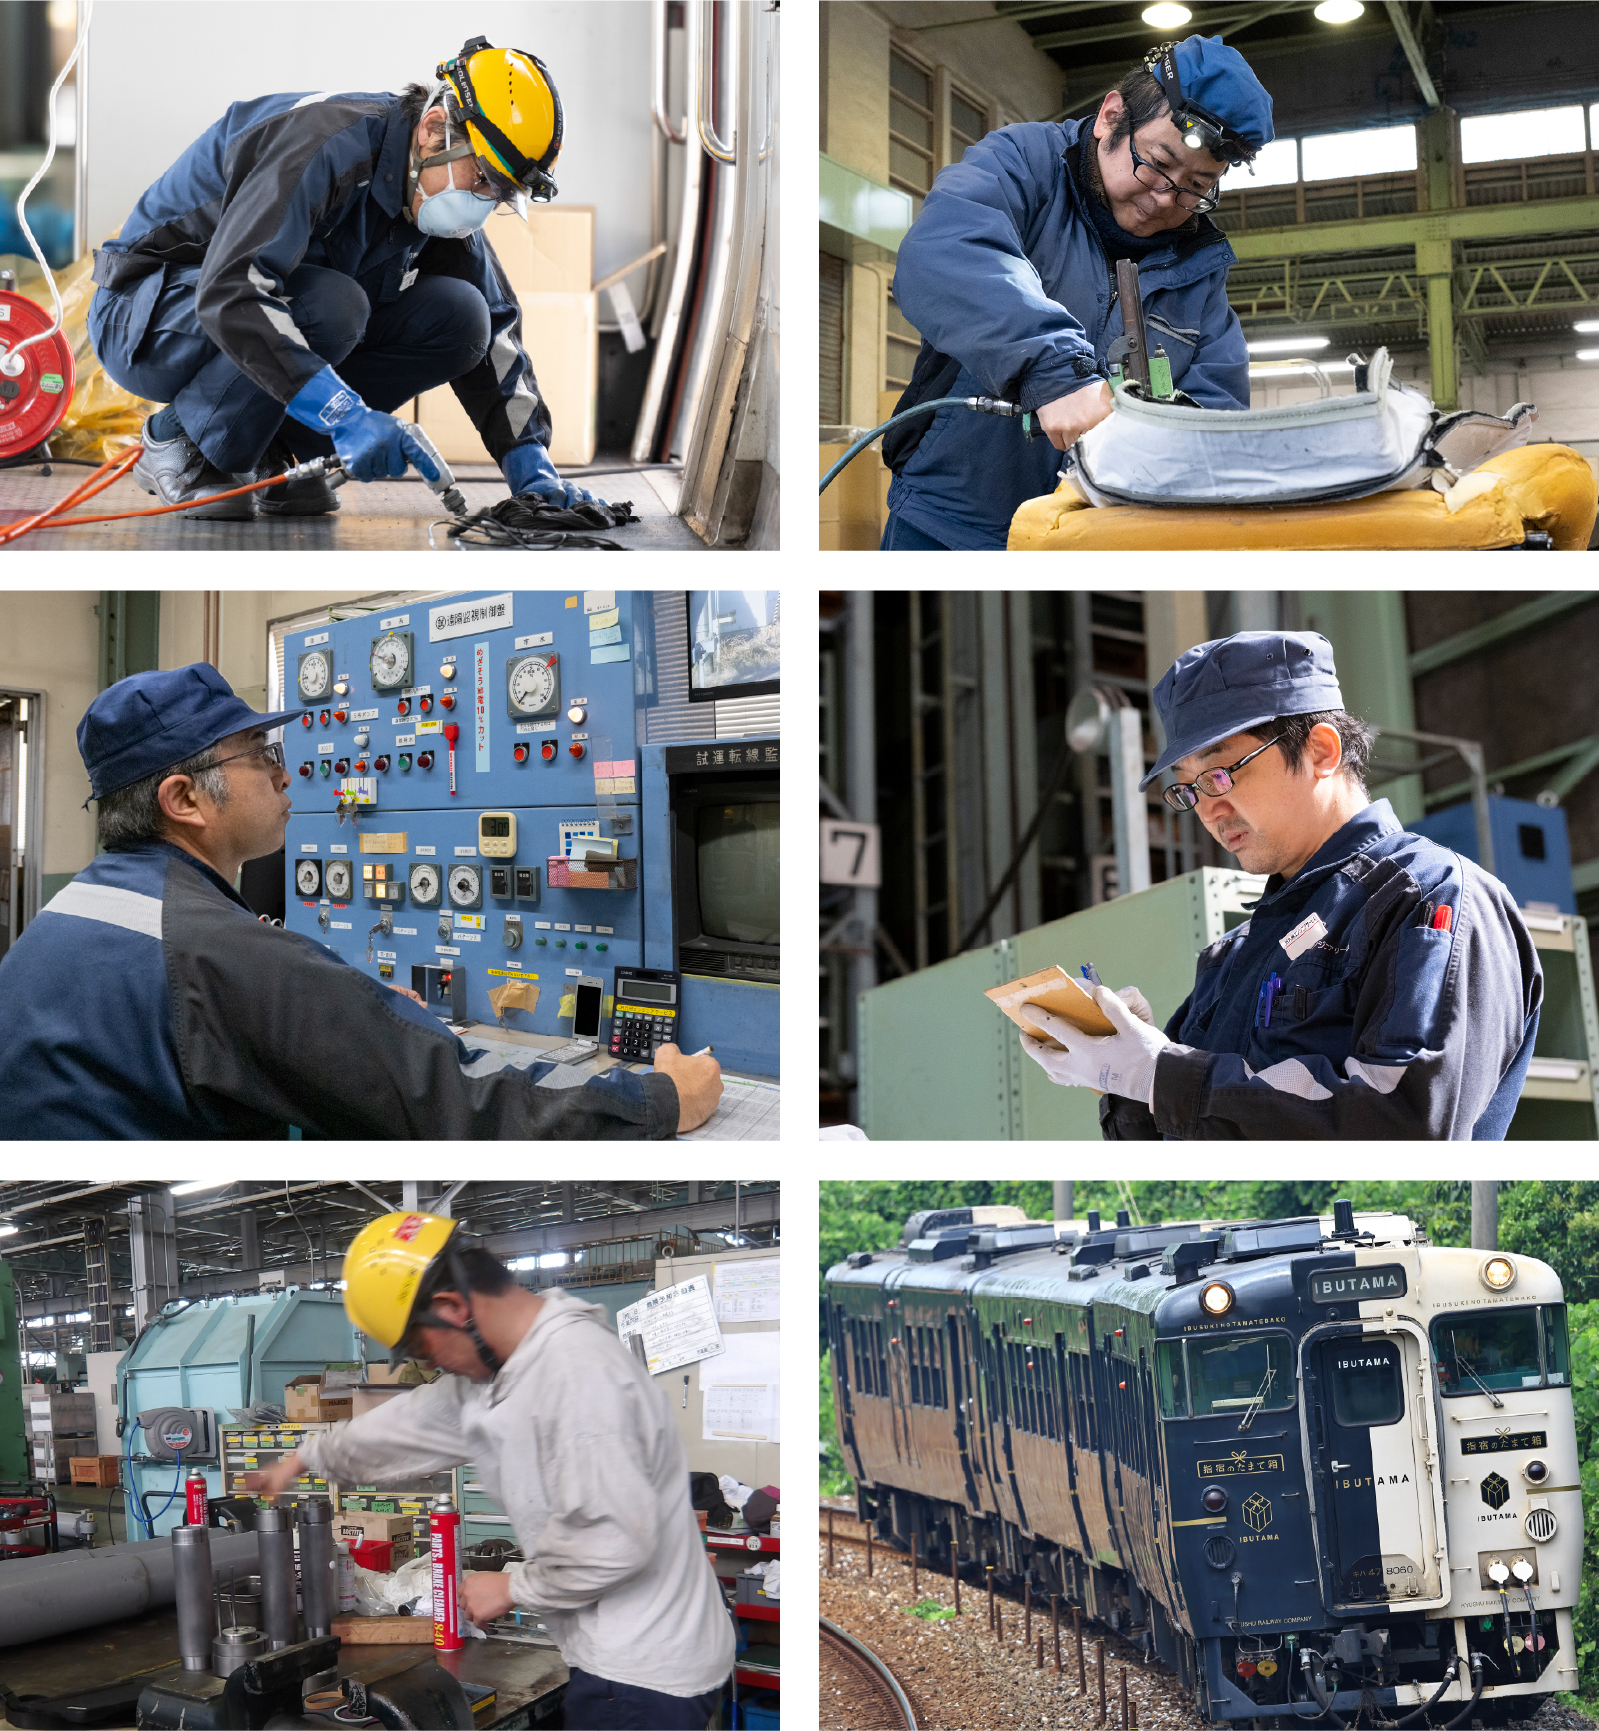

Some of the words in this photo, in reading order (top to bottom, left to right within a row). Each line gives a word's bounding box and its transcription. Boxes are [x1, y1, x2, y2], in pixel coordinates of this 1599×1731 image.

[831, 831, 866, 876] 7
[1314, 1274, 1398, 1295] IBUTAMA
[1183, 1323, 1218, 1332] IBUSUKI
[1338, 1357, 1390, 1369] IBUTAMA
[1466, 1435, 1542, 1452] 指宿のたまて箱
[1203, 1459, 1278, 1474] 指宿のたまて箱
[1335, 1474, 1410, 1490] IBUTAMA
[1477, 1512, 1518, 1522] IBUTAMA
[432, 1532, 444, 1560] PARTS
[1240, 1534, 1280, 1543] IBUTAMA
[432, 1563, 444, 1588] BRAKE
[1368, 1568, 1381, 1576] 47
[1386, 1566, 1414, 1575] 8060
[434, 1590, 446, 1622] CLEANER
[434, 1622, 444, 1646] 840
